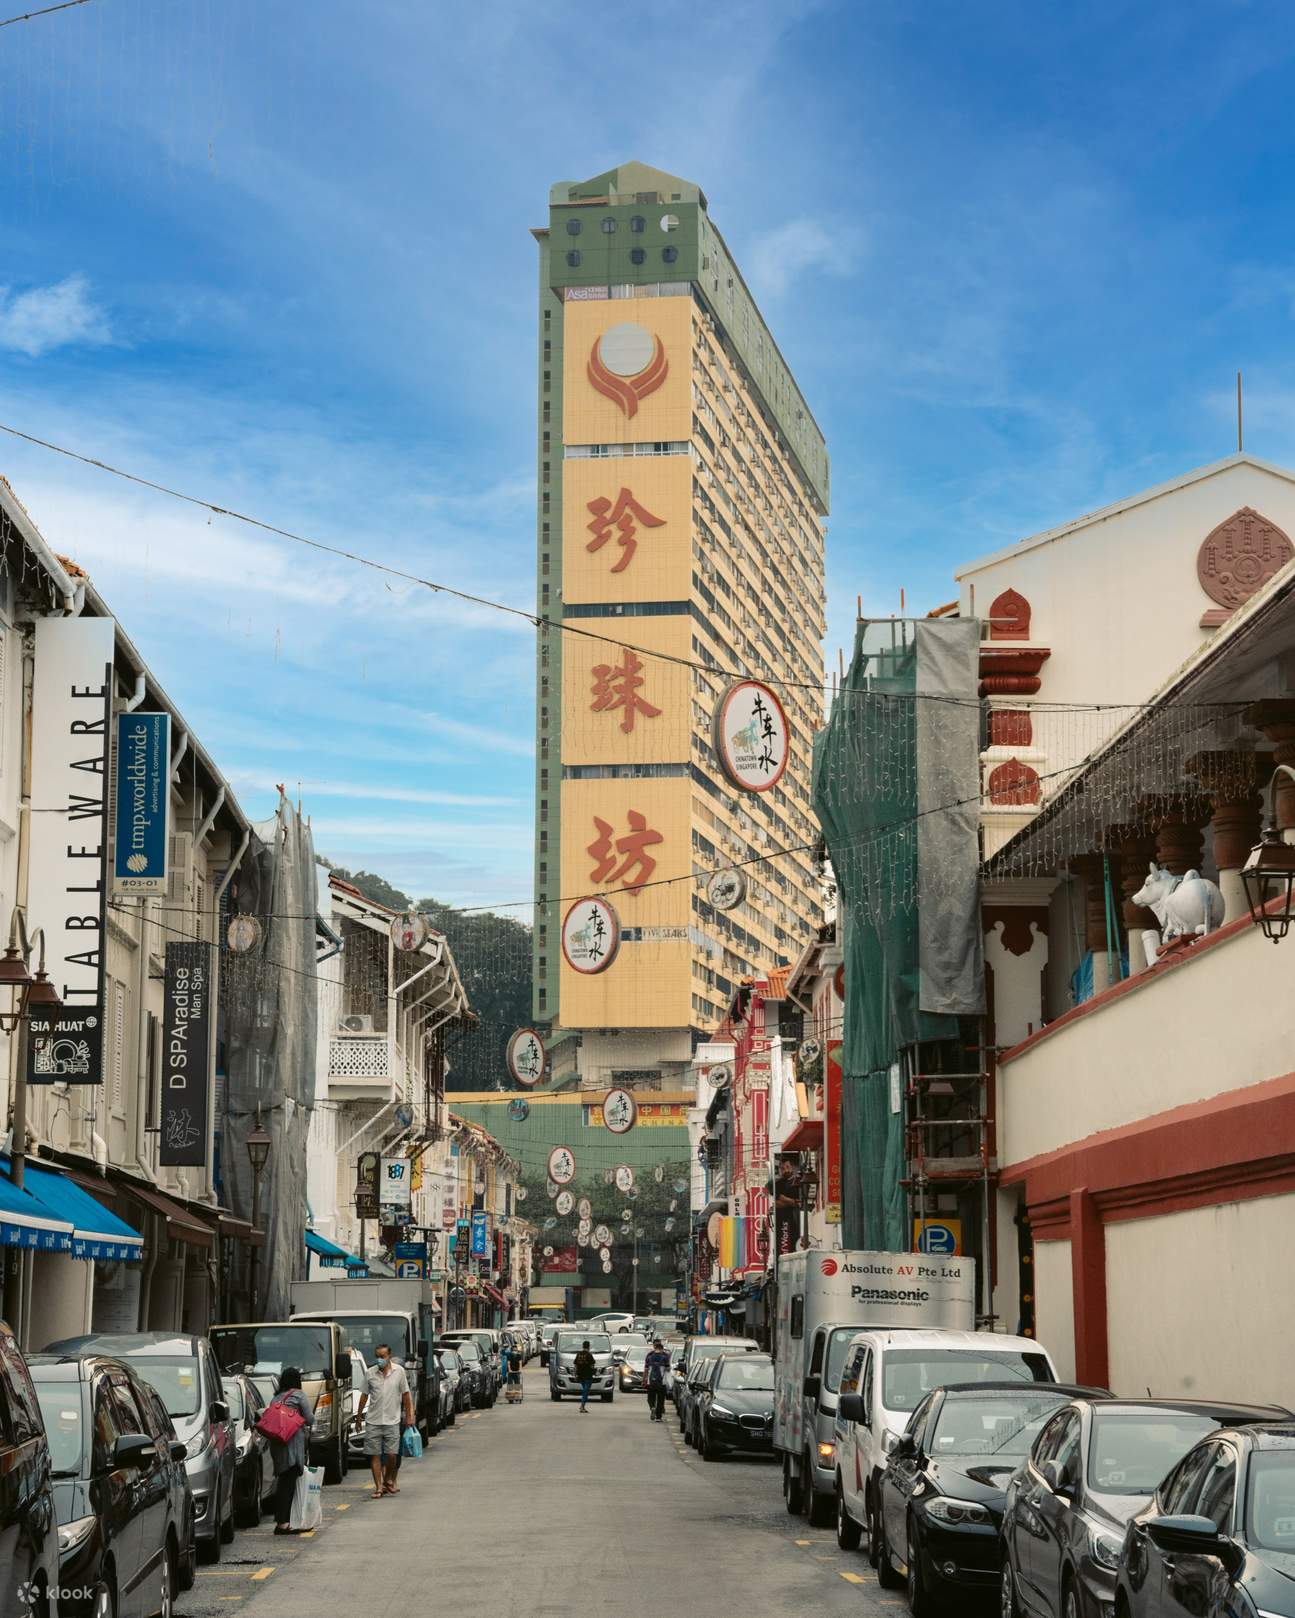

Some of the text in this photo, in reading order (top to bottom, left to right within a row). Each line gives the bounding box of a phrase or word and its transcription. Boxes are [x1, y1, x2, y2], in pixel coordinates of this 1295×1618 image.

[152, 716, 160, 770] communications
[127, 725, 151, 849] tmp.worldwide
[151, 778, 160, 813] advertising
[63, 685, 106, 999] TABLEWARE
[190, 967, 204, 1019] Man Spa
[30, 1021, 84, 1031] SIA HUAT
[169, 967, 189, 1089] D SPAradise
[841, 1263, 961, 1278] Absolute AV Pte Ltd
[851, 1285, 930, 1301] Panasonic
